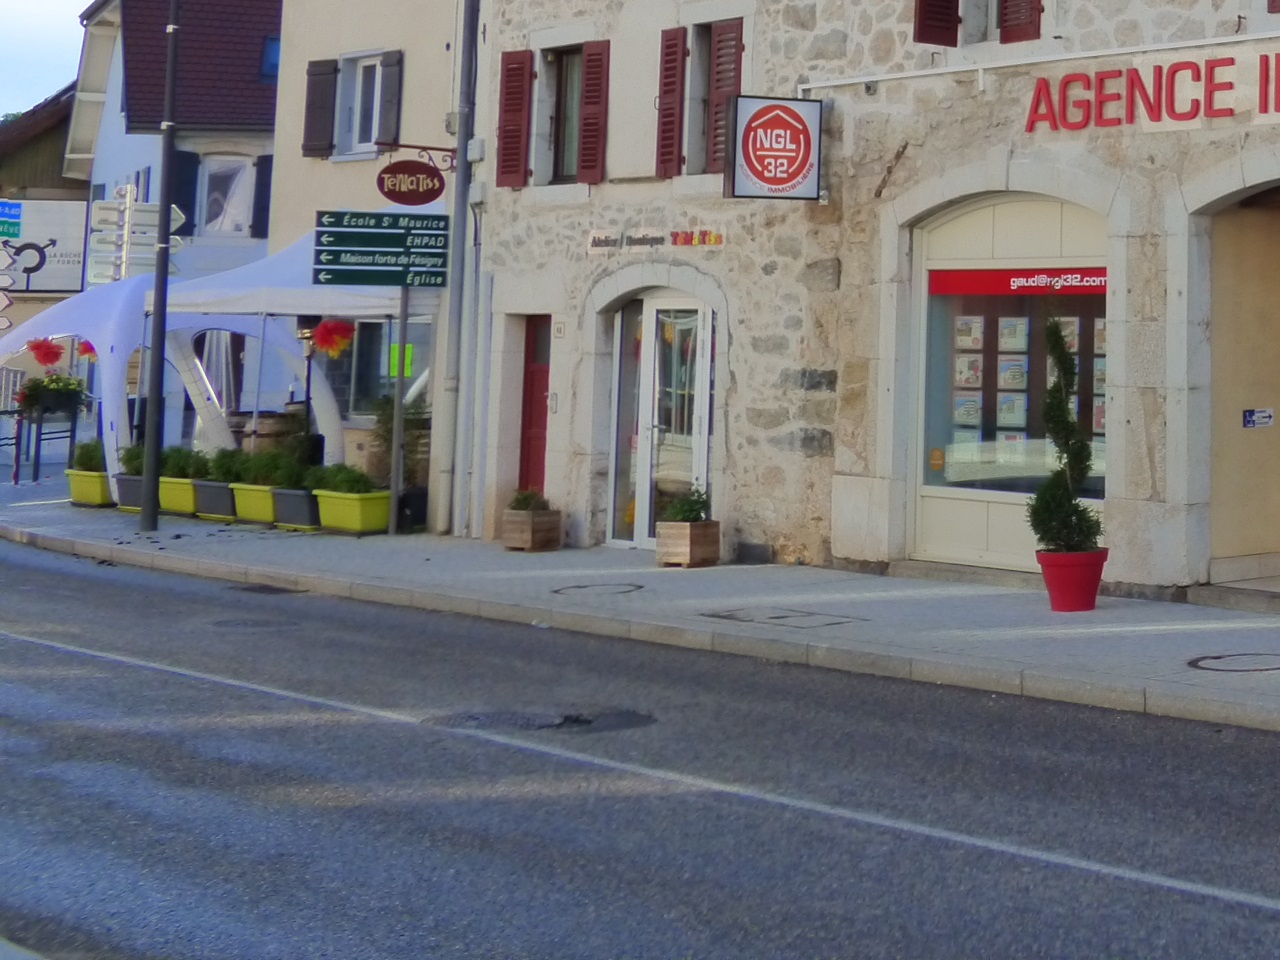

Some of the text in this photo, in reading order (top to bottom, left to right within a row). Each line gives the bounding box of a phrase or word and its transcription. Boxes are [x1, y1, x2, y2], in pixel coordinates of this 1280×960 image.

[1025, 57, 1235, 133] AGENCE
[757, 128, 796, 149] NGL
[764, 158, 788, 178] 32
[342, 213, 376, 226] École
[398, 217, 445, 228] Maurice
[406, 236, 445, 247] EHPAD
[340, 253, 373, 263] Maison
[374, 254, 396, 264] forte
[397, 254, 409, 264] de
[406, 271, 443, 286] Église
